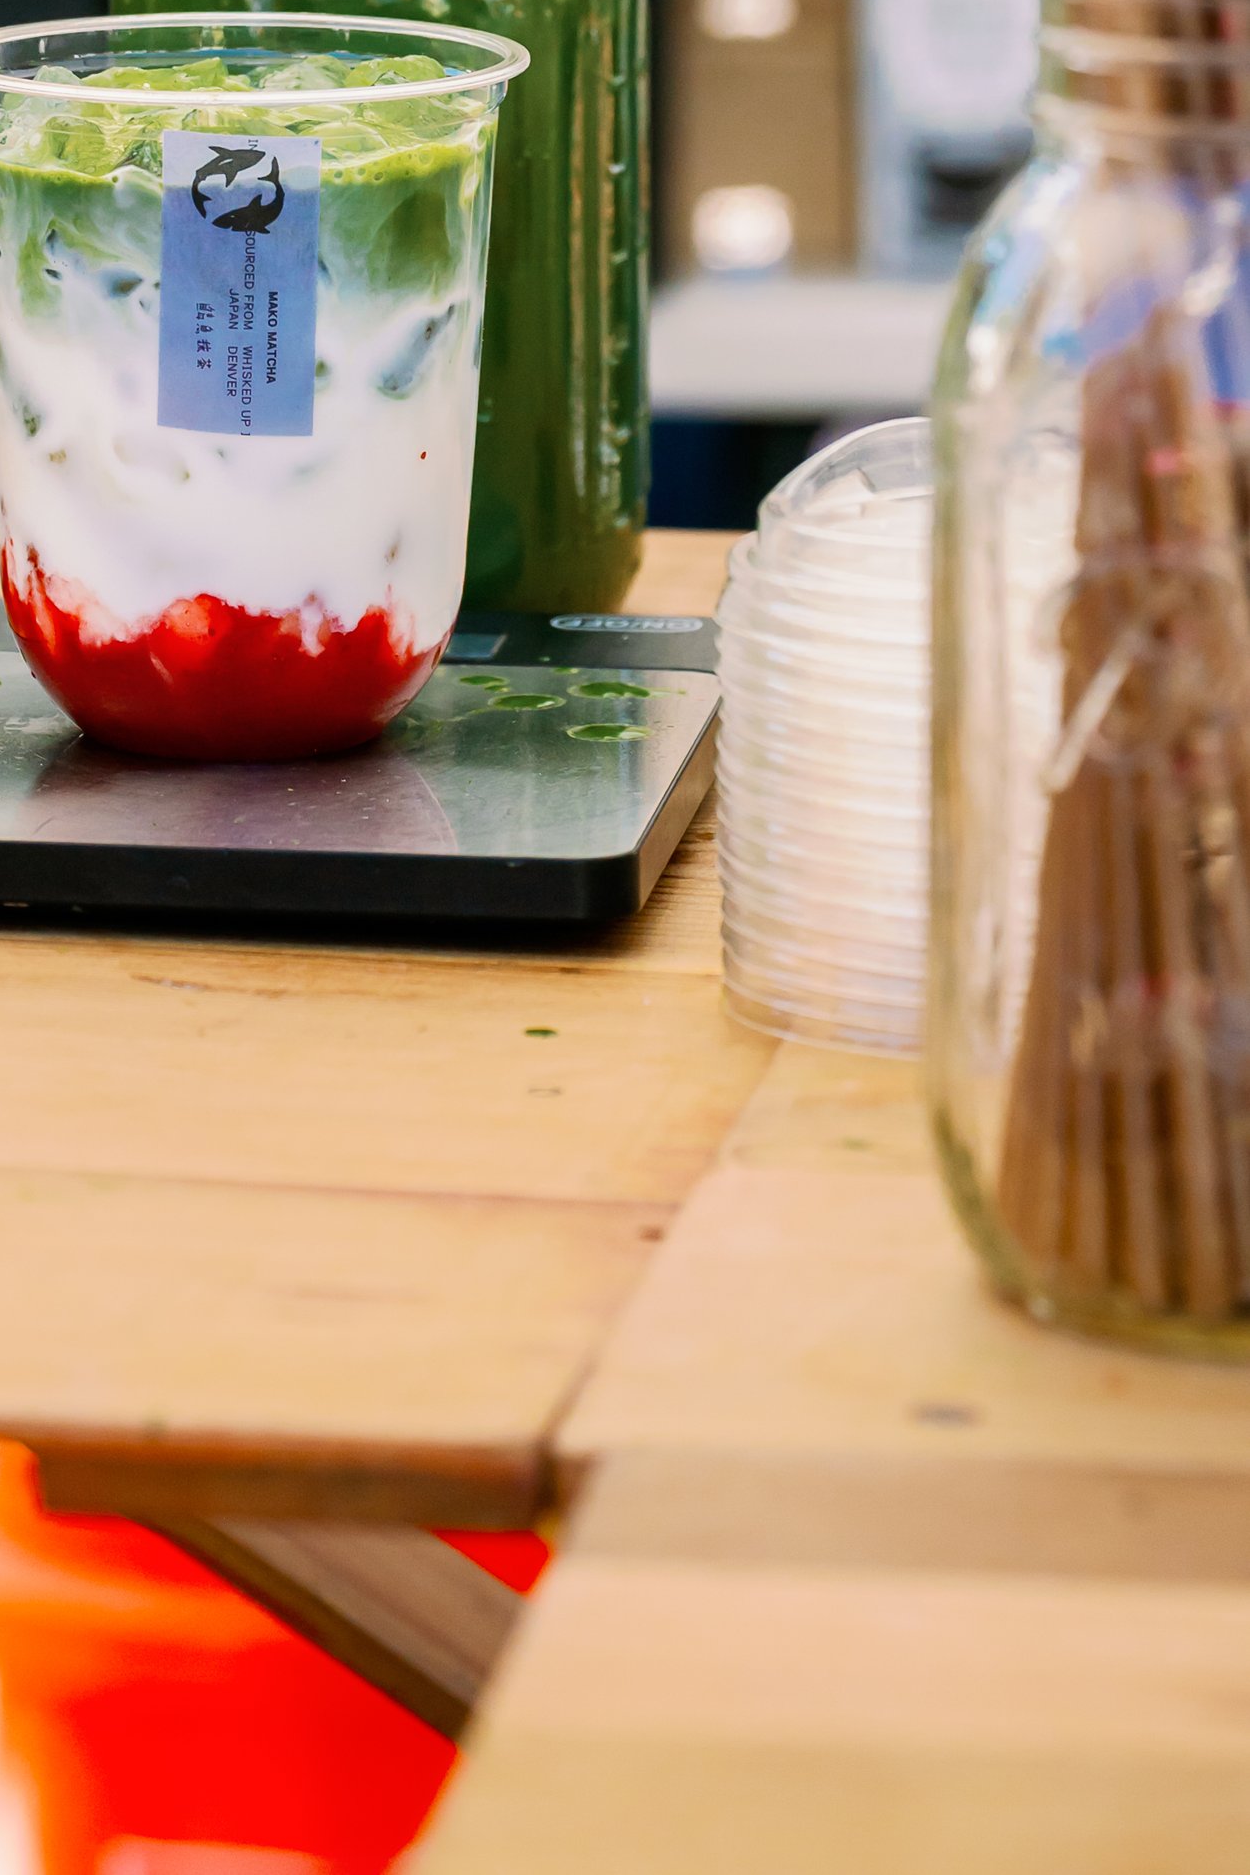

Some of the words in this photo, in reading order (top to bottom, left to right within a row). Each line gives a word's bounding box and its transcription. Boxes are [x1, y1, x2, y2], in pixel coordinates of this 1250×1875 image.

[243, 229, 257, 290] SOURCED
[227, 288, 240, 330] JAPAN
[243, 294, 255, 331] FROM
[267, 291, 279, 328] MAKO
[226, 345, 239, 397] DENVER
[241, 345, 254, 406] WHISKED
[265, 331, 278, 385] MATCHA
[240, 409, 252, 428] UP
